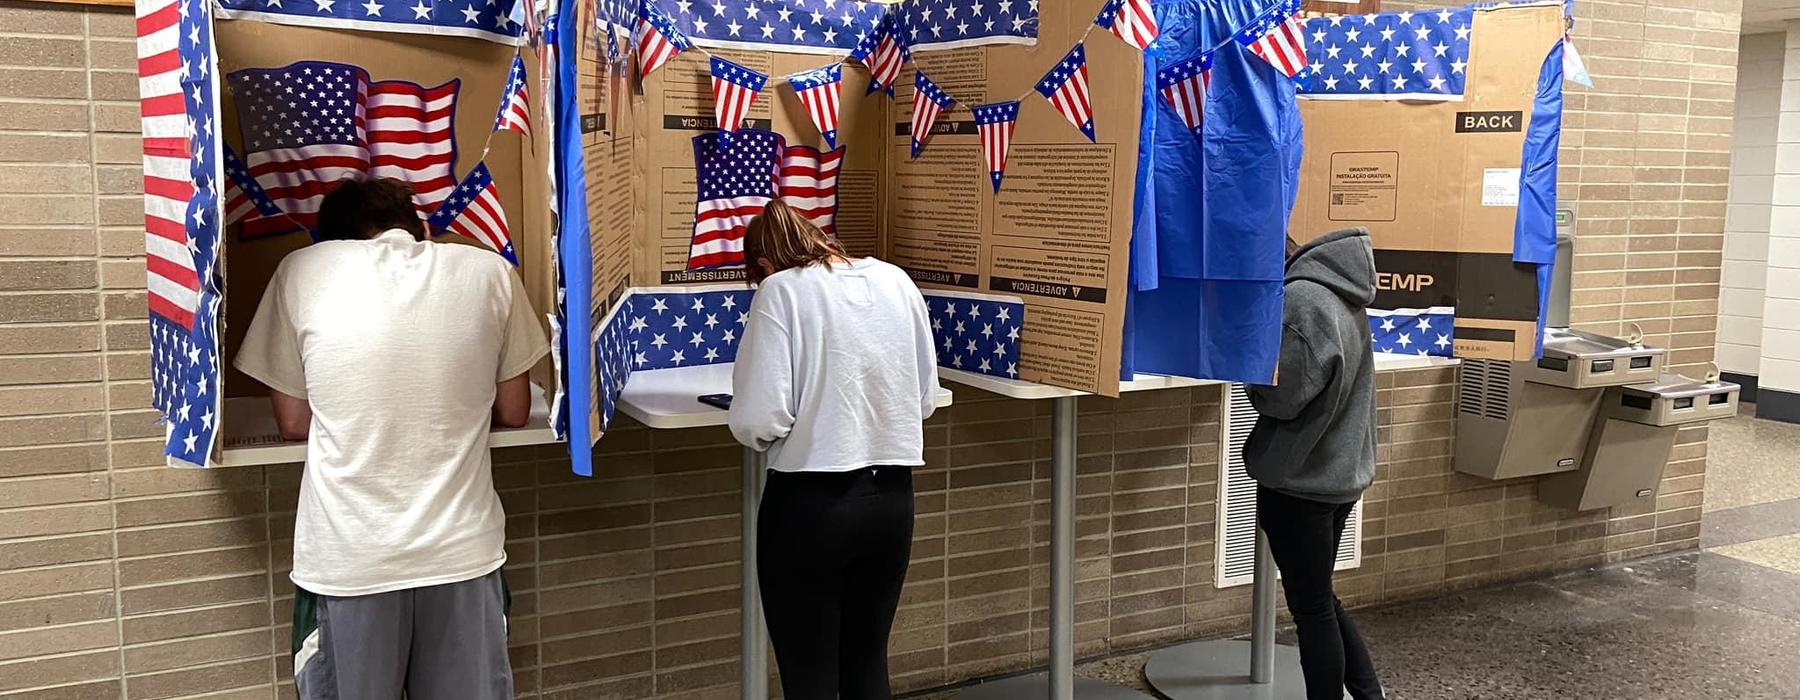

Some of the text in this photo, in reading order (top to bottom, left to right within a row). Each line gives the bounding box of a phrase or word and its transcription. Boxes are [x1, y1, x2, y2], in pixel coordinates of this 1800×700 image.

[1464, 115, 1514, 129] BACK
[668, 270, 746, 282] AVERTISSEMENT
[1012, 281, 1068, 296] ADVERTENCIA
